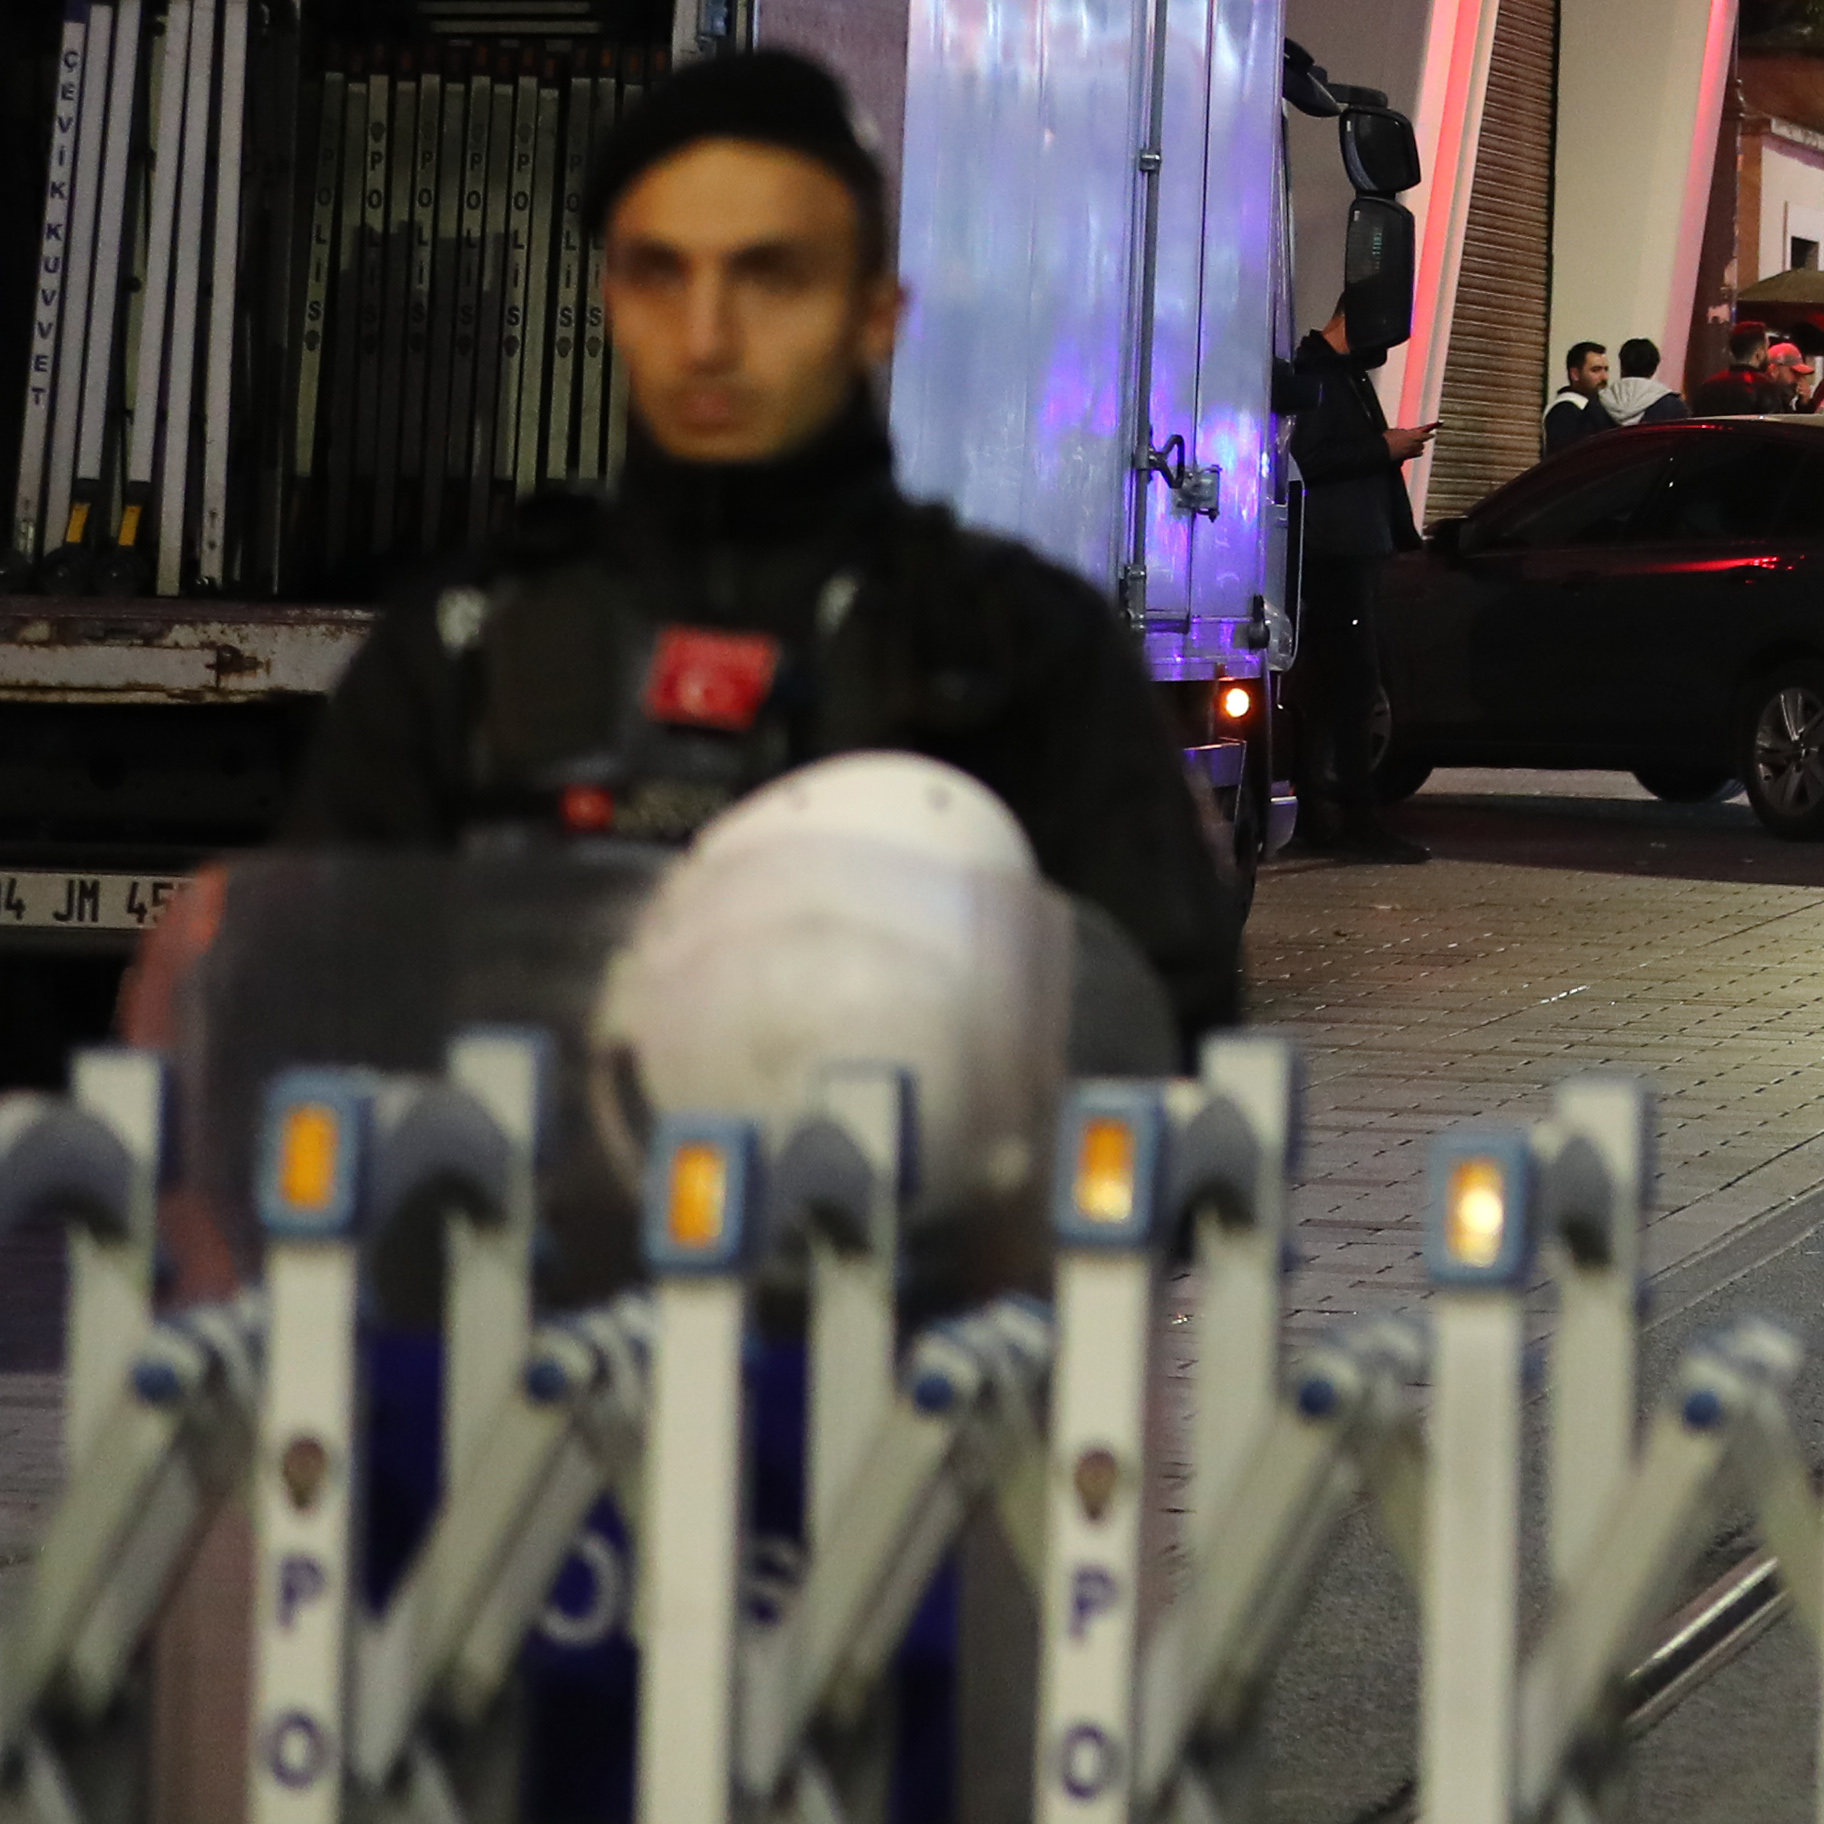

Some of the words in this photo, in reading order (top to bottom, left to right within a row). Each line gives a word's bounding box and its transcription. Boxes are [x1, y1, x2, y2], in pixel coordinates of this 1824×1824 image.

[49, 50, 79, 200] ÇEVİK
[31, 223, 62, 406] KUVVET
[52, 879, 100, 922] JM
[127, 881, 184, 923] 45
